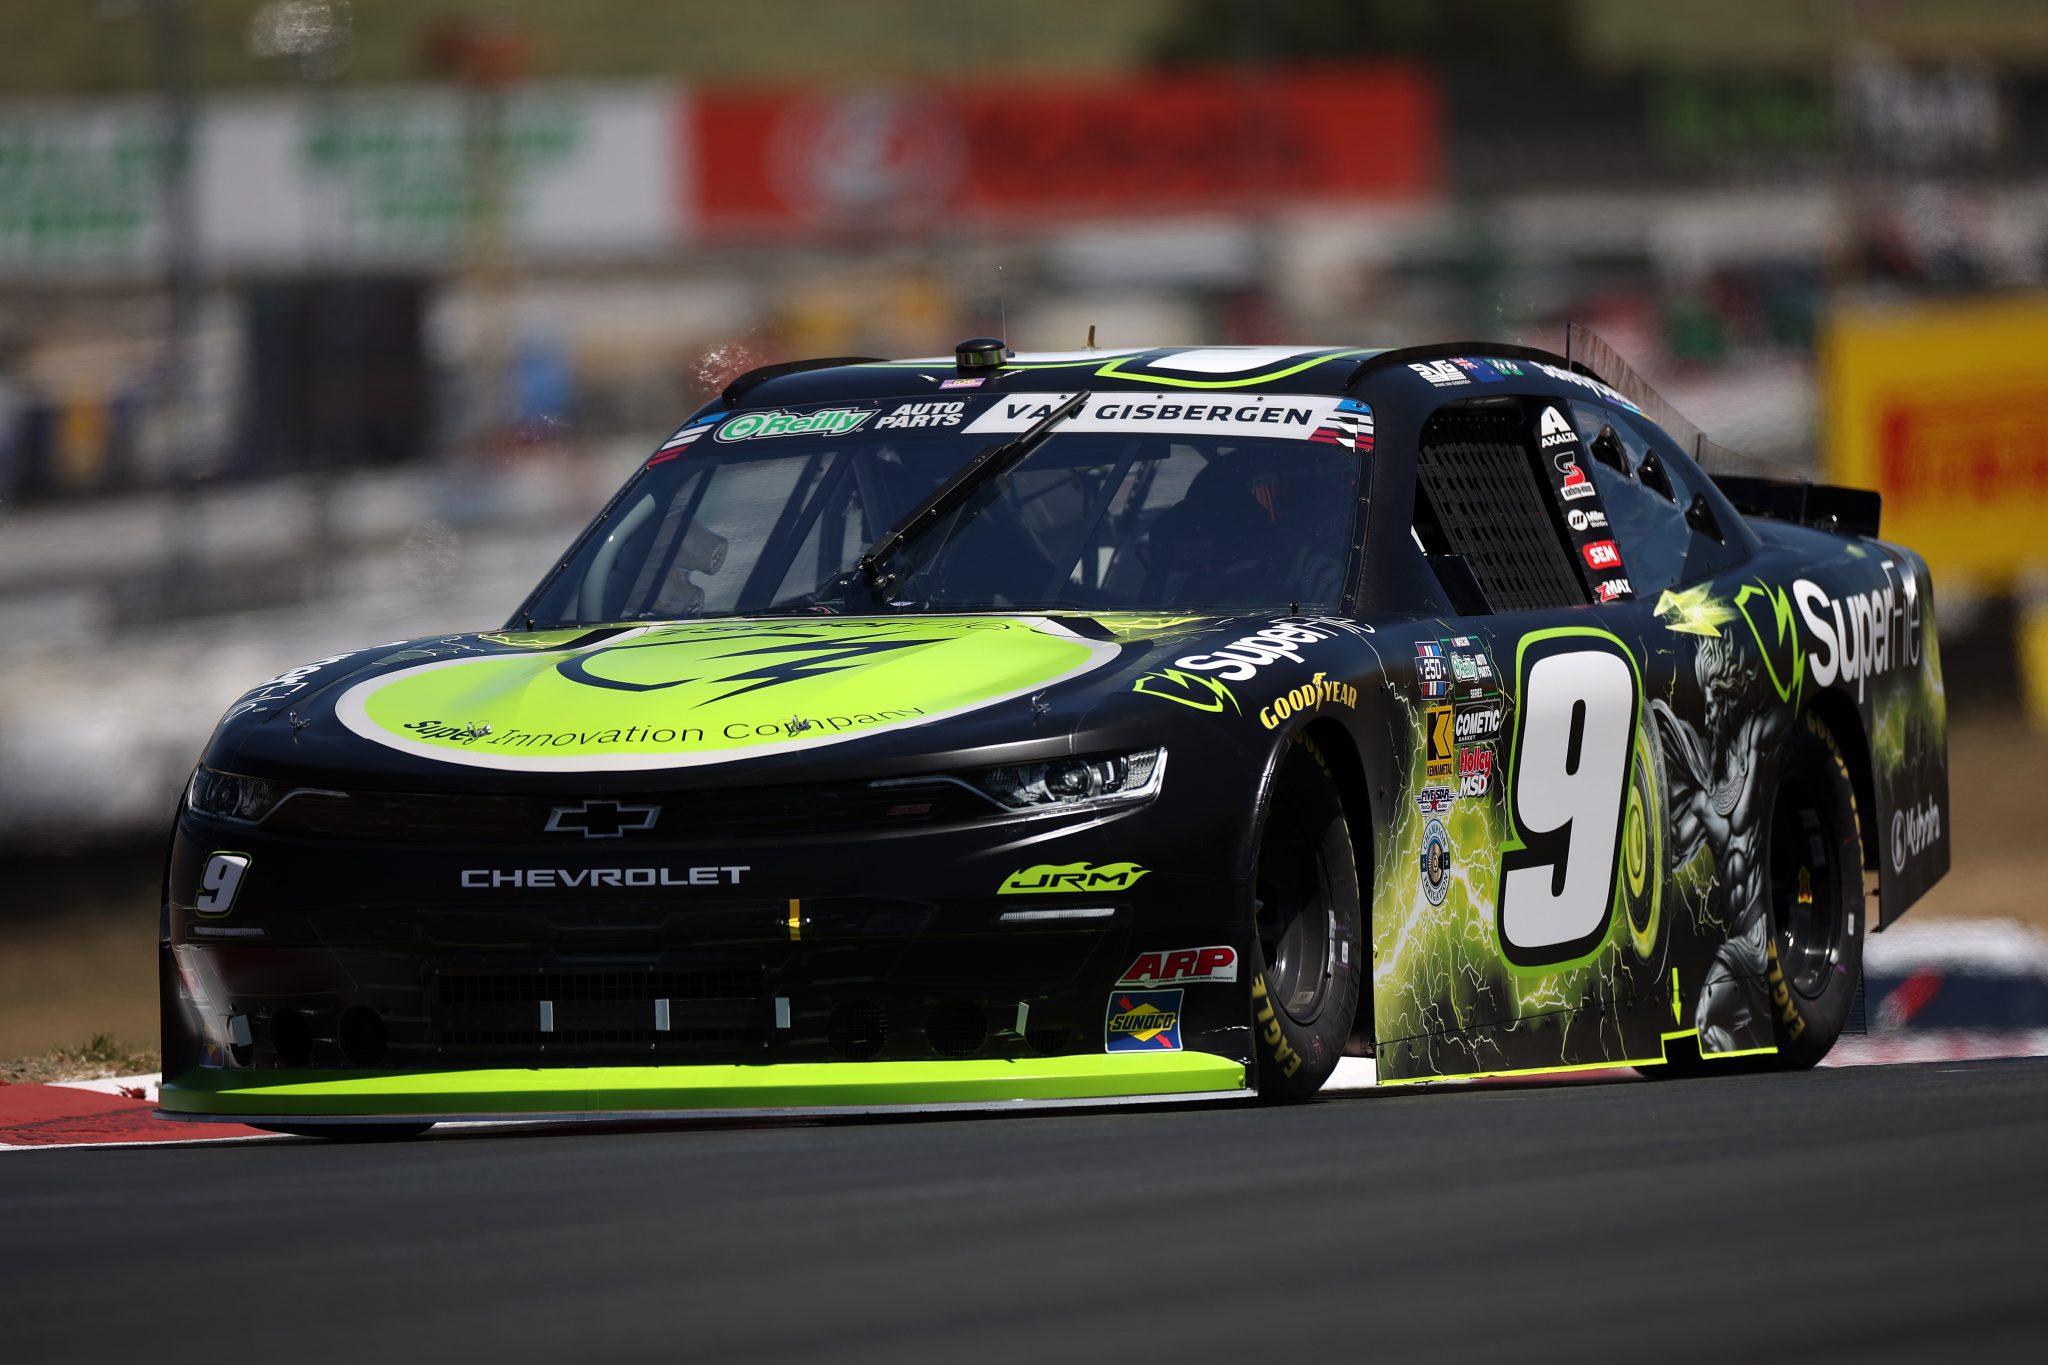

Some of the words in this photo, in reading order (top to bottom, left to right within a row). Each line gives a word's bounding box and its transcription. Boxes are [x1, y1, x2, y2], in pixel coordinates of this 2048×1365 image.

[890, 402, 966, 416] AUTO
[1095, 404, 1314, 425] GISBERGEN
[721, 410, 872, 439] O'Reilly
[874, 413, 964, 430] PARTS
[1541, 432, 1579, 448] AXALTA
[1589, 545, 1618, 565] SEM
[1423, 658, 1442, 680] 250
[1259, 676, 1358, 730] GOODYEAR
[486, 725, 704, 747] Innovation
[723, 707, 926, 740] Company
[1456, 709, 1500, 736] COMETIC
[1427, 763, 1453, 777] KENNAMETAL
[1459, 745, 1493, 778] Holley
[1460, 774, 1488, 798] MSD
[1503, 650, 1634, 949] 9
[196, 855, 248, 912] 9
[461, 866, 750, 887] CHEVROLET
[1010, 872, 1129, 893] JRM
[1121, 947, 1235, 980] ARP
[1111, 1014, 1174, 1030] SUNOCO
[1252, 973, 1302, 1079] EAGLE
